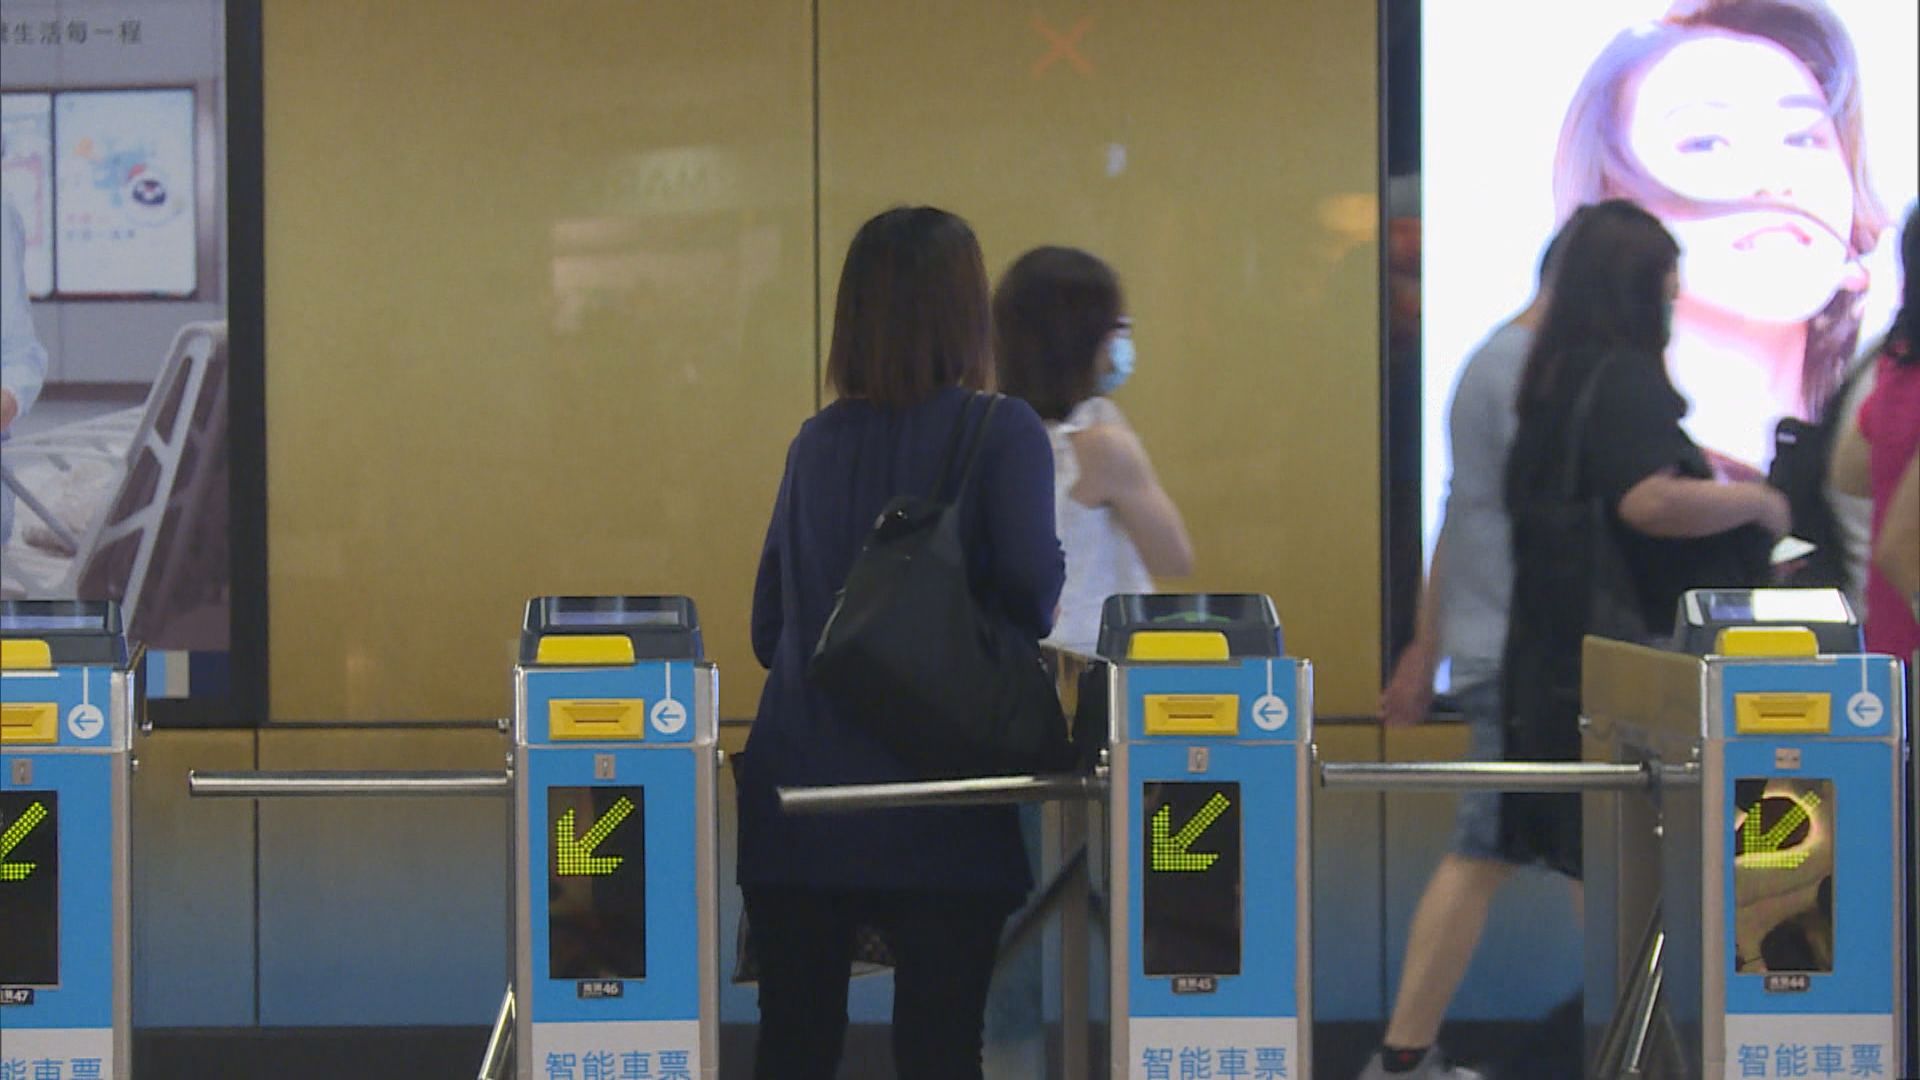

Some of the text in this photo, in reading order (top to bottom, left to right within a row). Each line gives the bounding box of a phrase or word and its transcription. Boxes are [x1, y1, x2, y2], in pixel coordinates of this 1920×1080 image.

[545, 1051, 690, 1080] 智能車票
[1142, 1046, 1287, 1080] 智能車票
[1738, 1043, 1883, 1078] 智能車票
